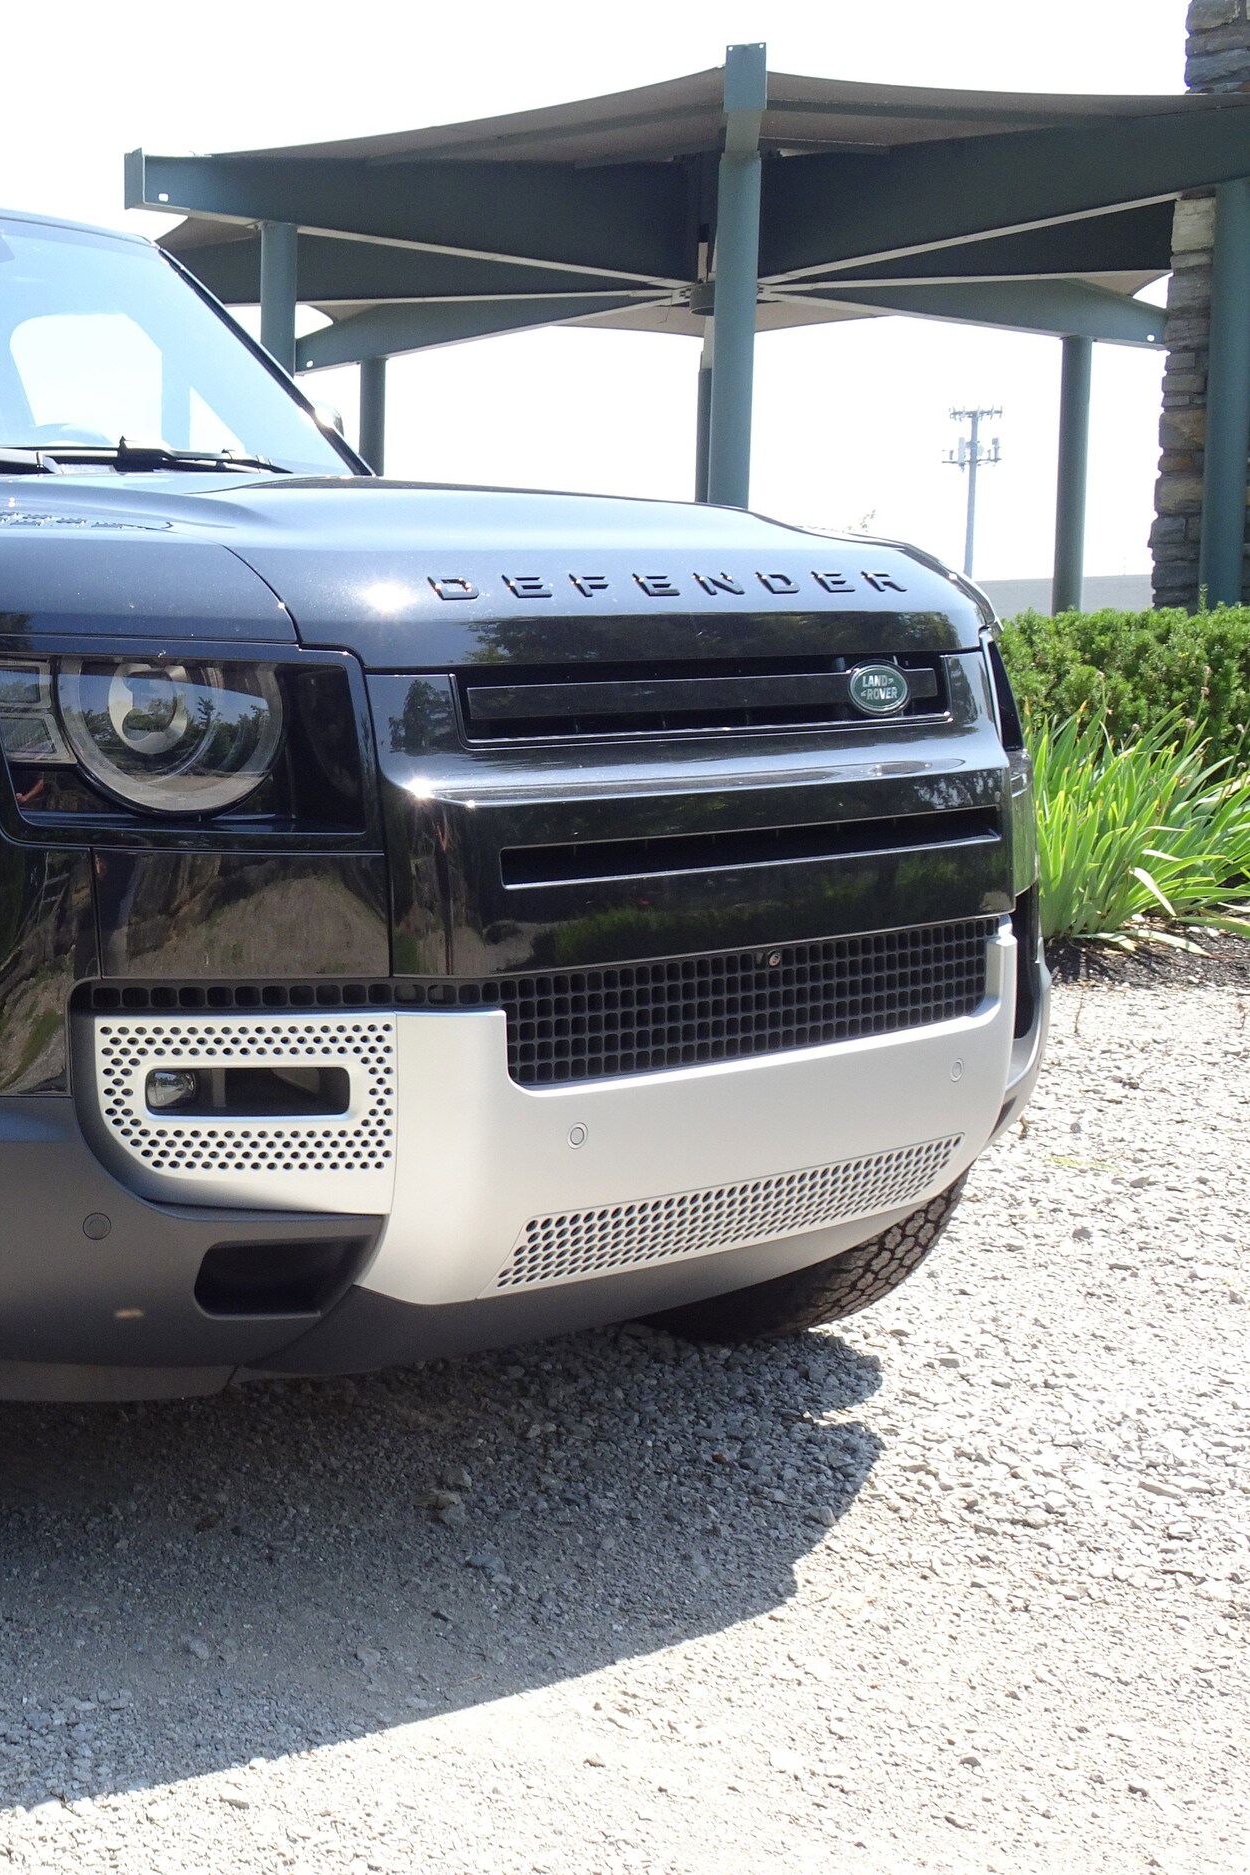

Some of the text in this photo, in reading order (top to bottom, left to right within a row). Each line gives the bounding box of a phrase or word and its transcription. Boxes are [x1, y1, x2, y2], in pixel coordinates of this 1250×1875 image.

[427, 569, 908, 600] DEFENDER
[862, 675, 888, 687] LAND
[866, 687, 898, 700] ROVER
